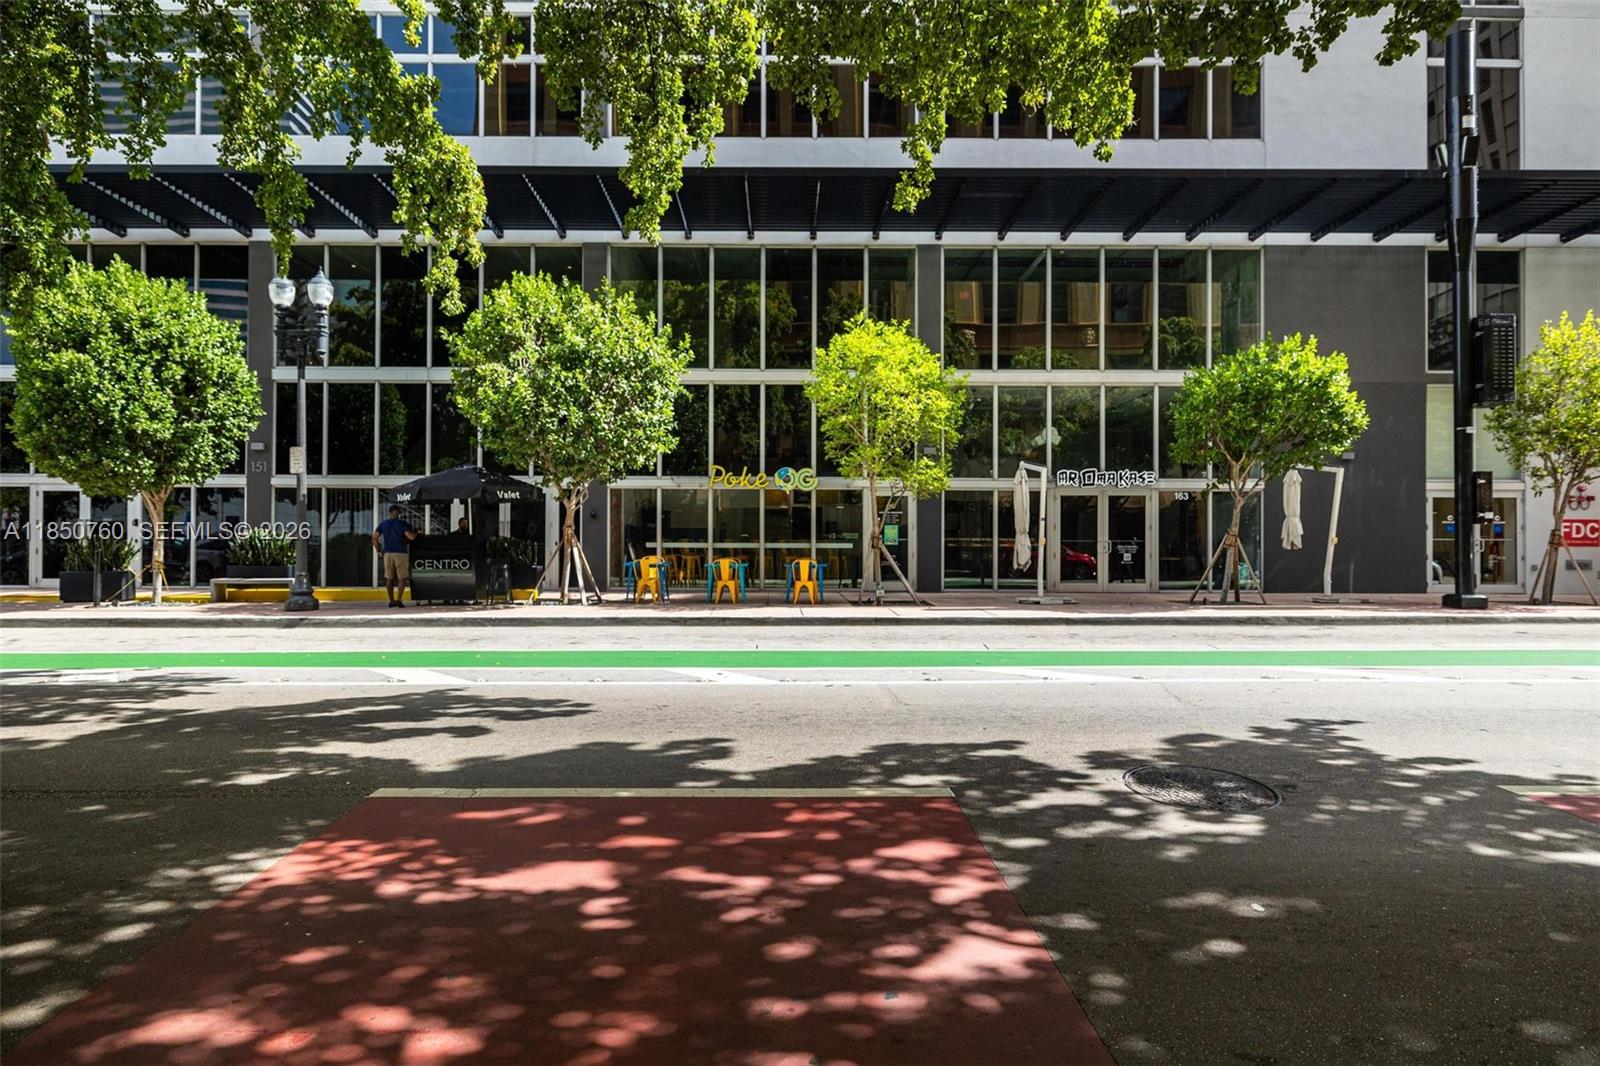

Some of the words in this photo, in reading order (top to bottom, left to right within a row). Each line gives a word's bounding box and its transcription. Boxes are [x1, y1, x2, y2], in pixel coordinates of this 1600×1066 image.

[251, 461, 267, 472] 151
[709, 465, 770, 489] Poke
[774, 467, 819, 495] OG
[496, 491, 521, 500] Valet
[1174, 492, 1189, 501] 163
[1561, 522, 1600, 539] FDC
[414, 559, 470, 570] CENTRO
